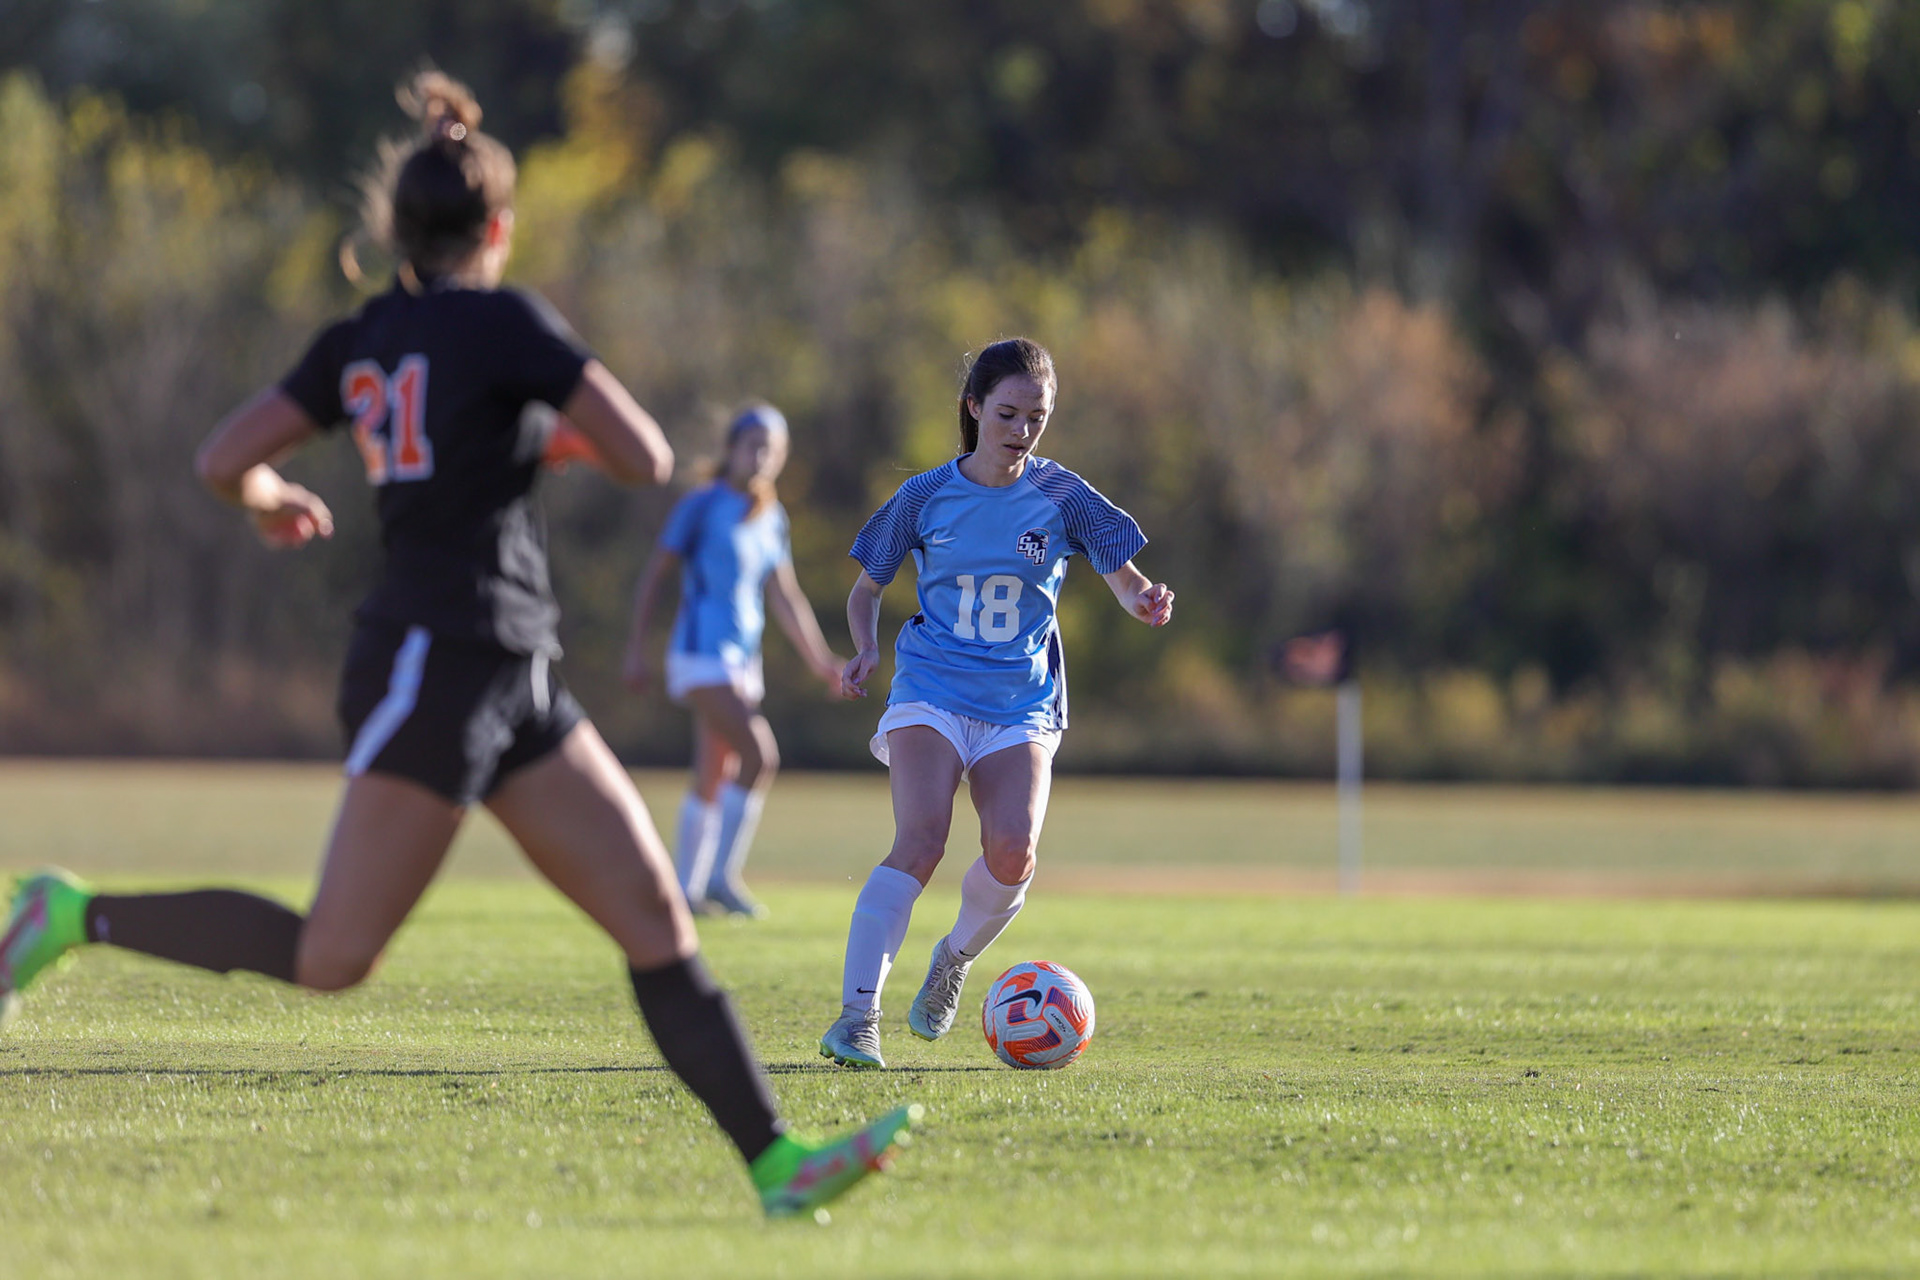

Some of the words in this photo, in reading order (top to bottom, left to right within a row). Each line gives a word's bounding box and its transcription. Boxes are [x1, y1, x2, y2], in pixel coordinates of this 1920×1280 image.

[340, 353, 434, 485] 21
[1019, 535, 1046, 564] SBA
[953, 574, 1024, 642] 18
